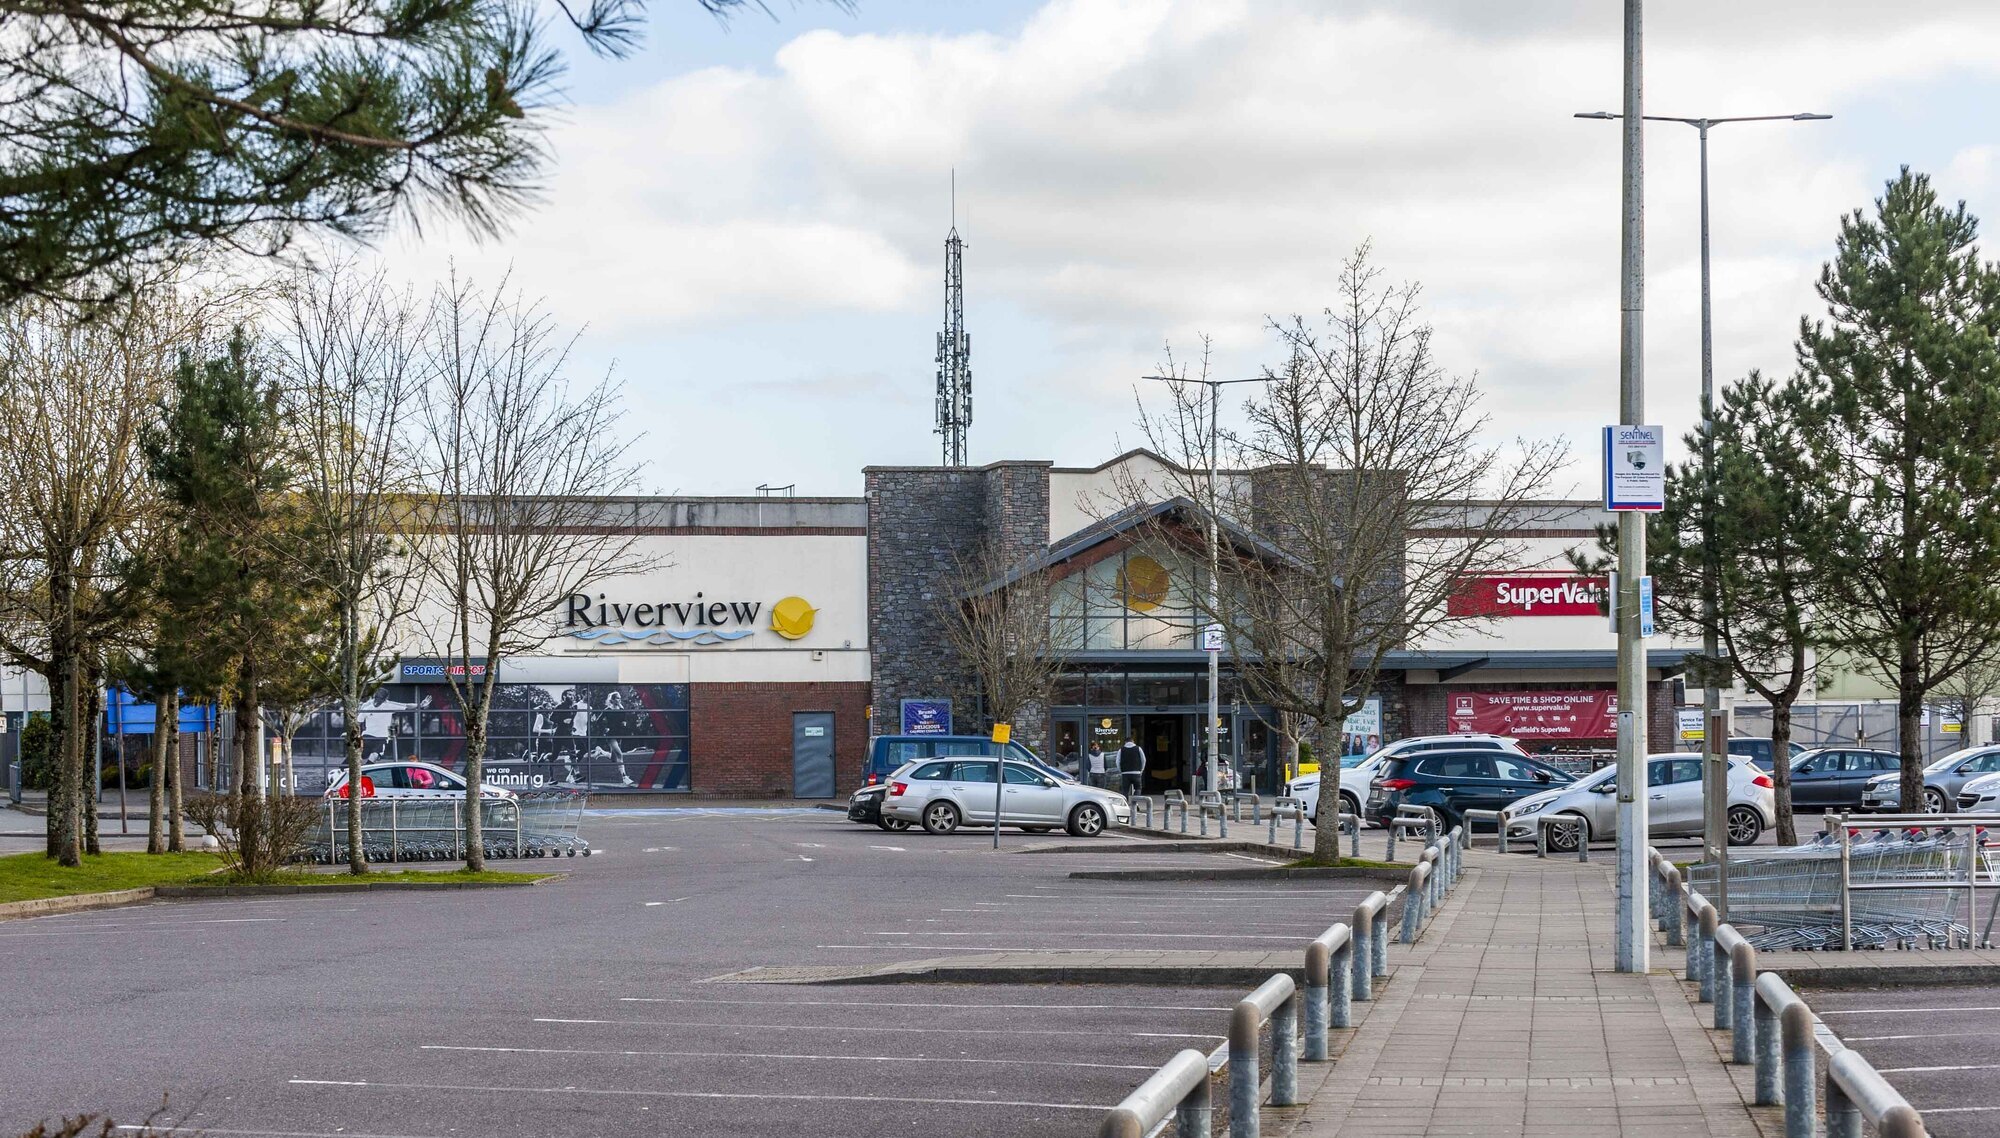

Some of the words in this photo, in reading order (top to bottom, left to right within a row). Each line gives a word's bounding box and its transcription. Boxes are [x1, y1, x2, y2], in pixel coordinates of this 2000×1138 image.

[1620, 429, 1654, 440] SENTINEL
[567, 592, 761, 627] Riverview
[1512, 704, 1571, 712] www.supervalu.ie
[1541, 726, 1571, 734] SuperValu
[486, 771, 544, 788] running
